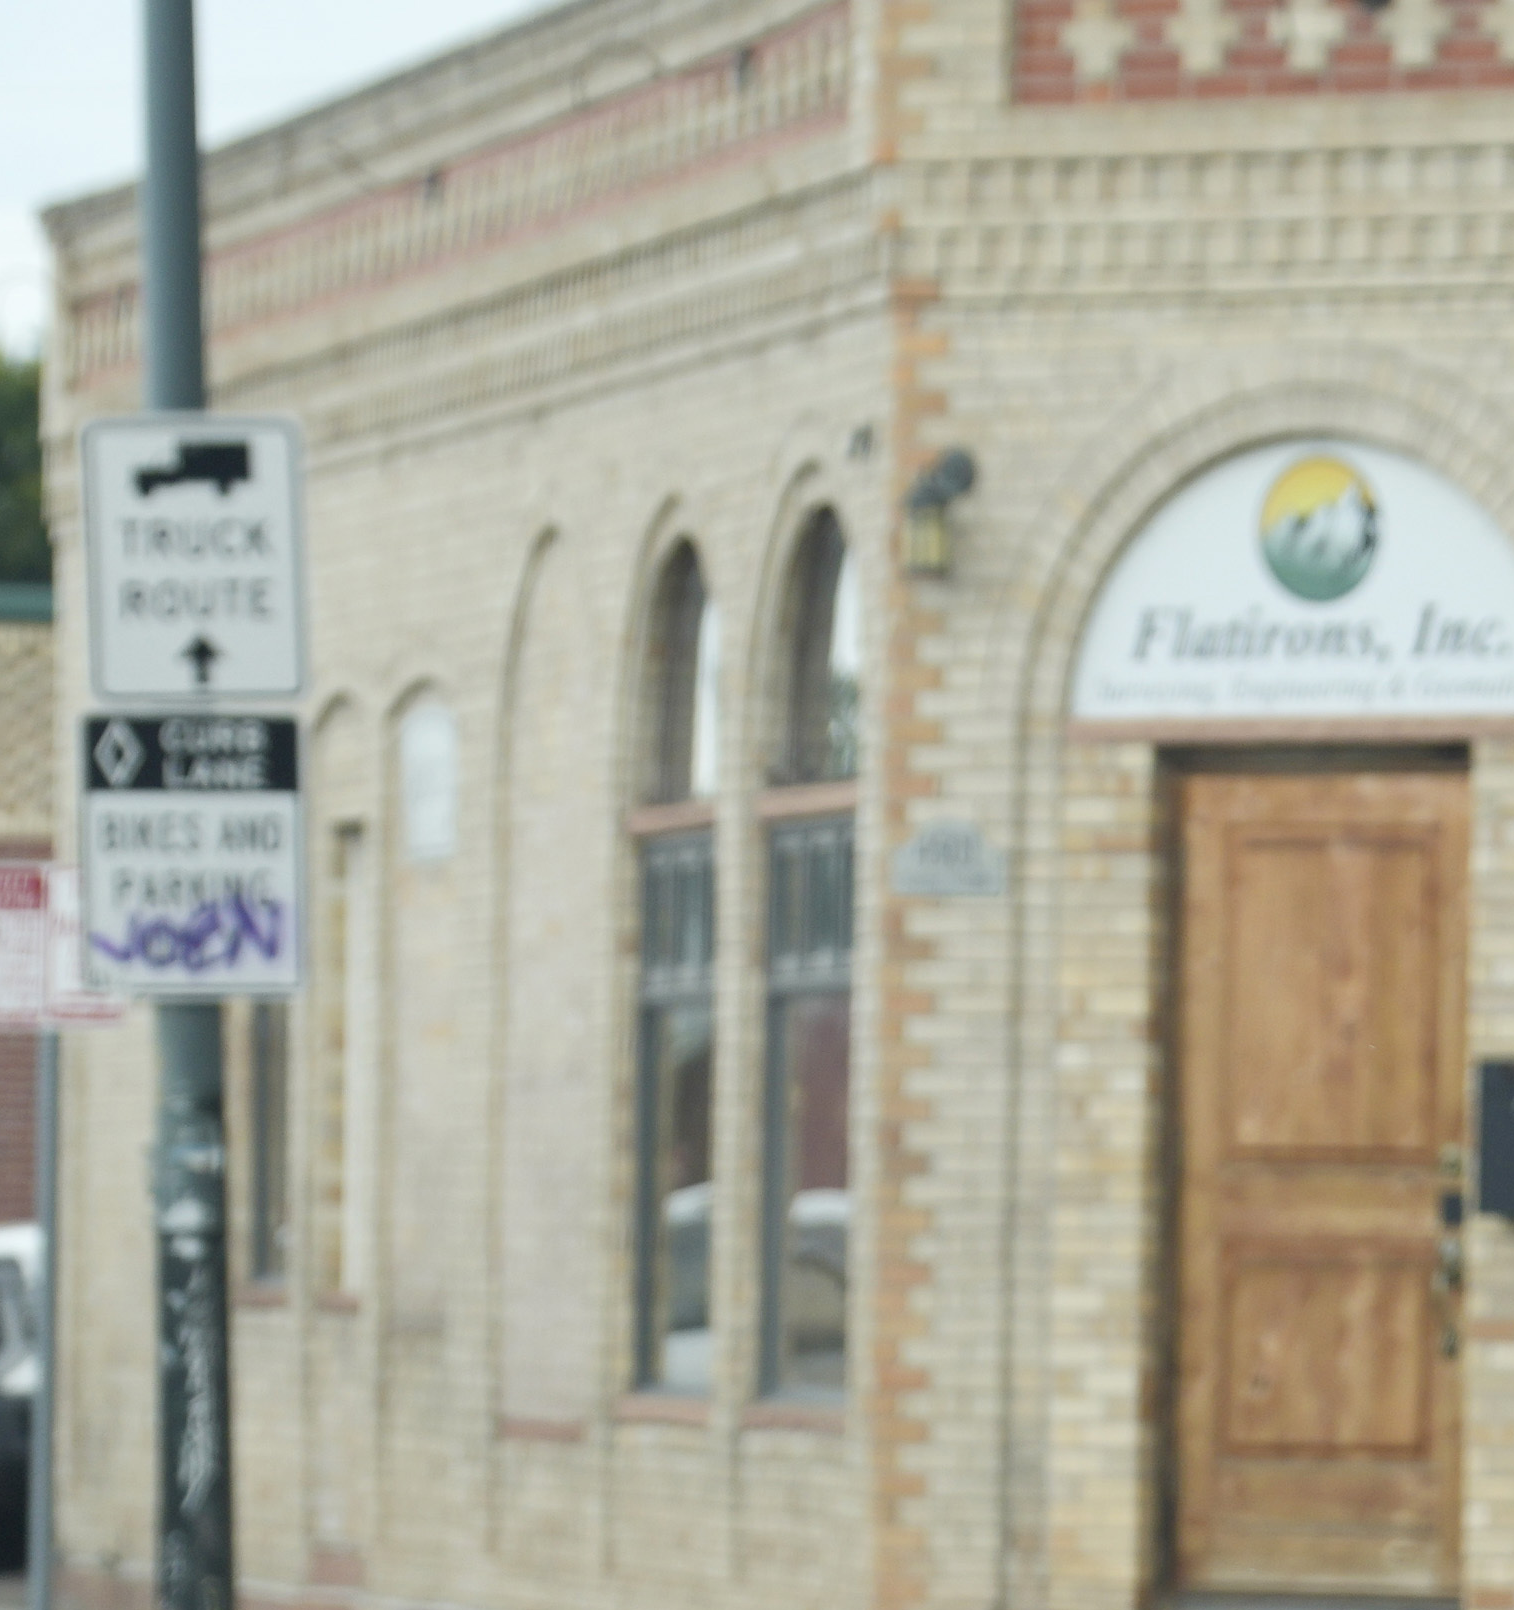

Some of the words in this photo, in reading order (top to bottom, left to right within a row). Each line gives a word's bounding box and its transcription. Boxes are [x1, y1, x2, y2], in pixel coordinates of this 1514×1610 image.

[118, 517, 272, 558] TRUCK
[119, 579, 273, 619] ROUTE
[1130, 605, 1394, 664] Flatirons,
[164, 756, 266, 786] LANE
[98, 813, 202, 853] BIKES
[219, 815, 279, 853] AND
[111, 868, 276, 908] PARKING
